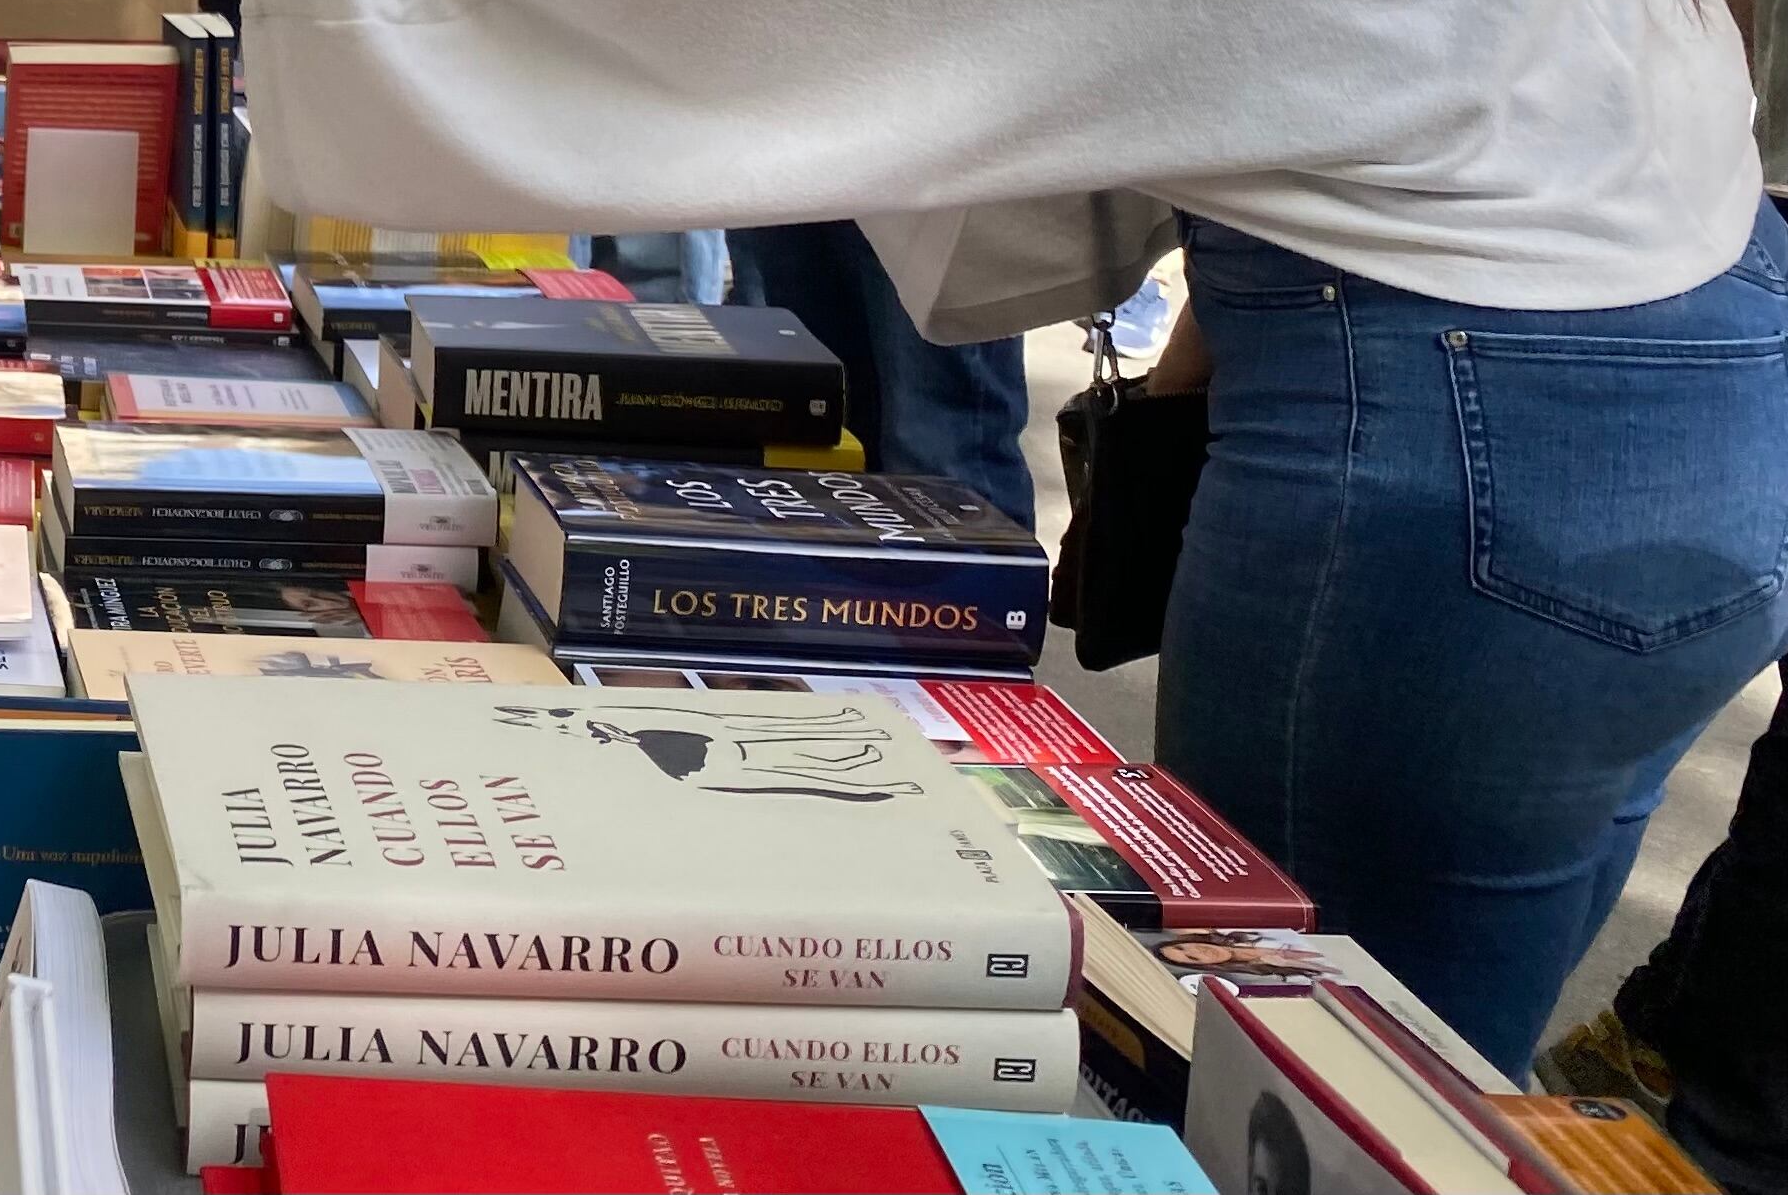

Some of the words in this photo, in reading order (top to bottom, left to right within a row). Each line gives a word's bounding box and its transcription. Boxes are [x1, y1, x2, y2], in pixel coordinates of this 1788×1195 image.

[465, 368, 603, 421] MENTIRA
[667, 479, 735, 510] LOS
[736, 477, 826, 520] TRES
[809, 471, 926, 543] MUNDOS
[93, 576, 126, 615] MÍNGUEZ
[600, 566, 616, 629] SANTIAGO
[653, 589, 718, 619] LOS
[732, 593, 809, 623] TRES
[821, 598, 979, 632] MUNDOS
[224, 787, 293, 867] JULIA
[295, 743, 353, 868] NAVARRO
[343, 751, 426, 868] CUANDO
[423, 778, 496, 870] ELLOS
[482, 774, 547, 830] VAN
[521, 831, 567, 872] SE
[224, 924, 386, 969] JULIA
[408, 930, 680, 976] NAVARRO
[713, 933, 843, 962] CUANDO
[855, 937, 954, 964] ELLOS
[781, 967, 820, 990] SE
[825, 968, 887, 992] VAN
[233, 1021, 394, 1067] JULIA
[416, 1029, 688, 1077] NAVARRO
[721, 1036, 852, 1064] CUANDO
[861, 1039, 962, 1066] ELLOS
[789, 1070, 828, 1092] SE
[834, 1071, 897, 1094] VAN
